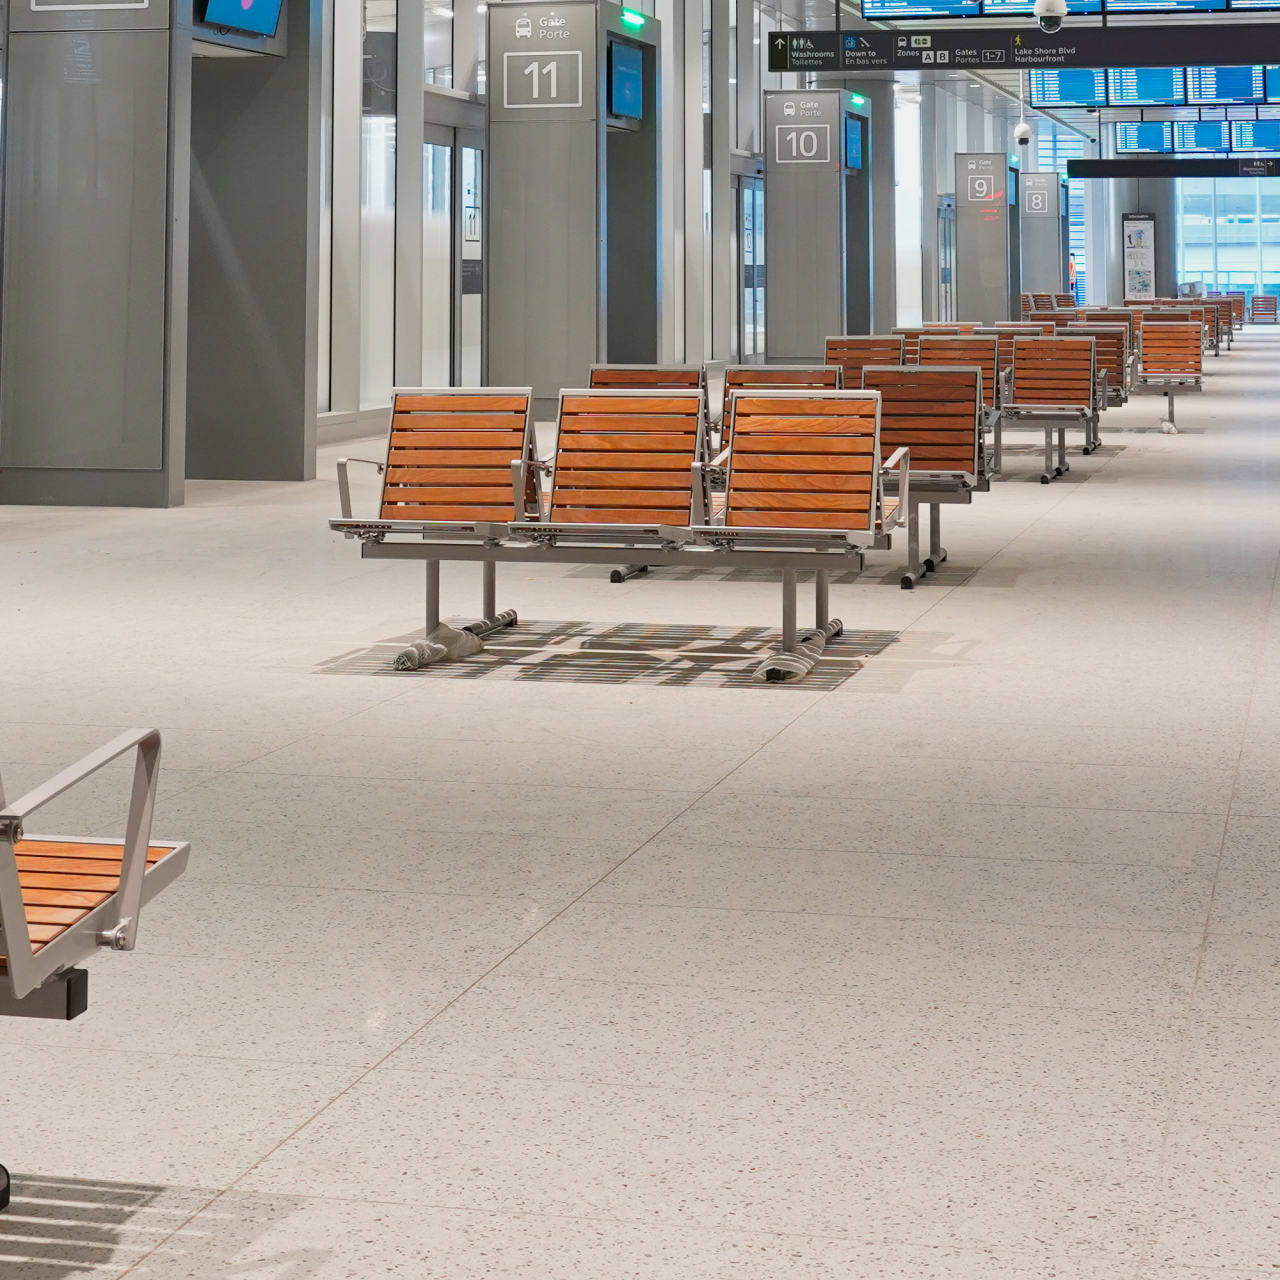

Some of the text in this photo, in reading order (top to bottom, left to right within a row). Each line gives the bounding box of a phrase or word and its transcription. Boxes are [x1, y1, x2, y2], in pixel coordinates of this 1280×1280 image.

[539, 16, 566, 27] Gate
[539, 29, 570, 39] Porte
[924, 53, 946, 61] A B
[523, 61, 557, 98] 11
[800, 109, 822, 117] Porte
[786, 130, 818, 157] 10
[975, 180, 987, 197] 9
[1032, 194, 1042, 209] 8
